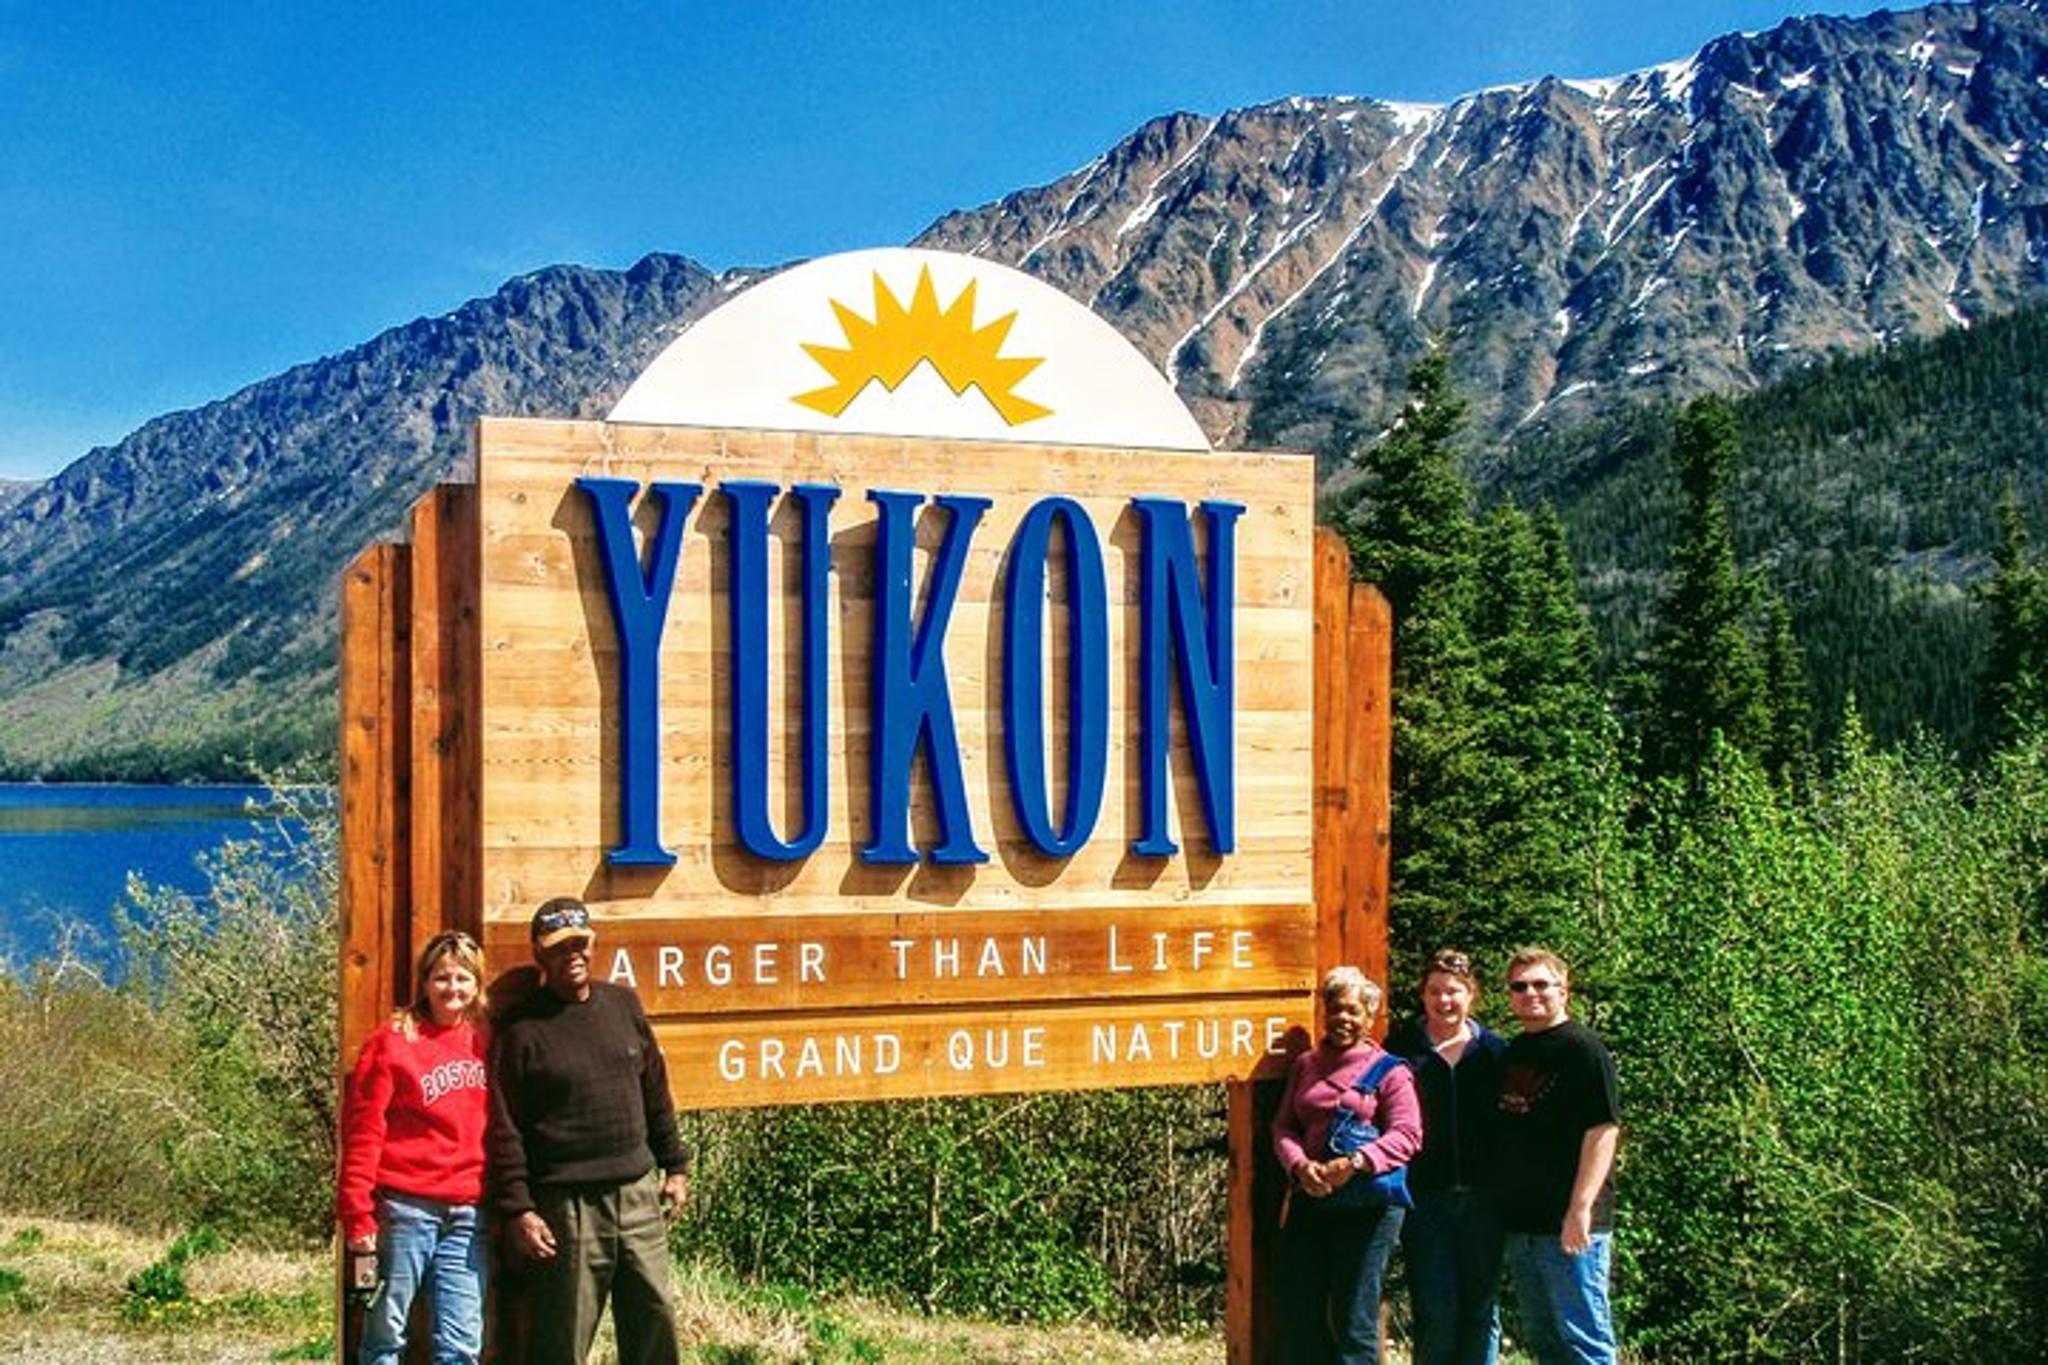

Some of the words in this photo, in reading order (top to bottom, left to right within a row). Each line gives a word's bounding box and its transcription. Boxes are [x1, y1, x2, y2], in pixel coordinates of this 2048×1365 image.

[575, 476, 1247, 866] YUKON
[608, 943, 827, 987] ARGER
[890, 936, 1047, 979] THAN
[719, 1034, 901, 1082] GRAND
[949, 1026, 1047, 1072] QUE
[1092, 1017, 1287, 1062] NATURE
[420, 1059, 487, 1107] BOSTO
